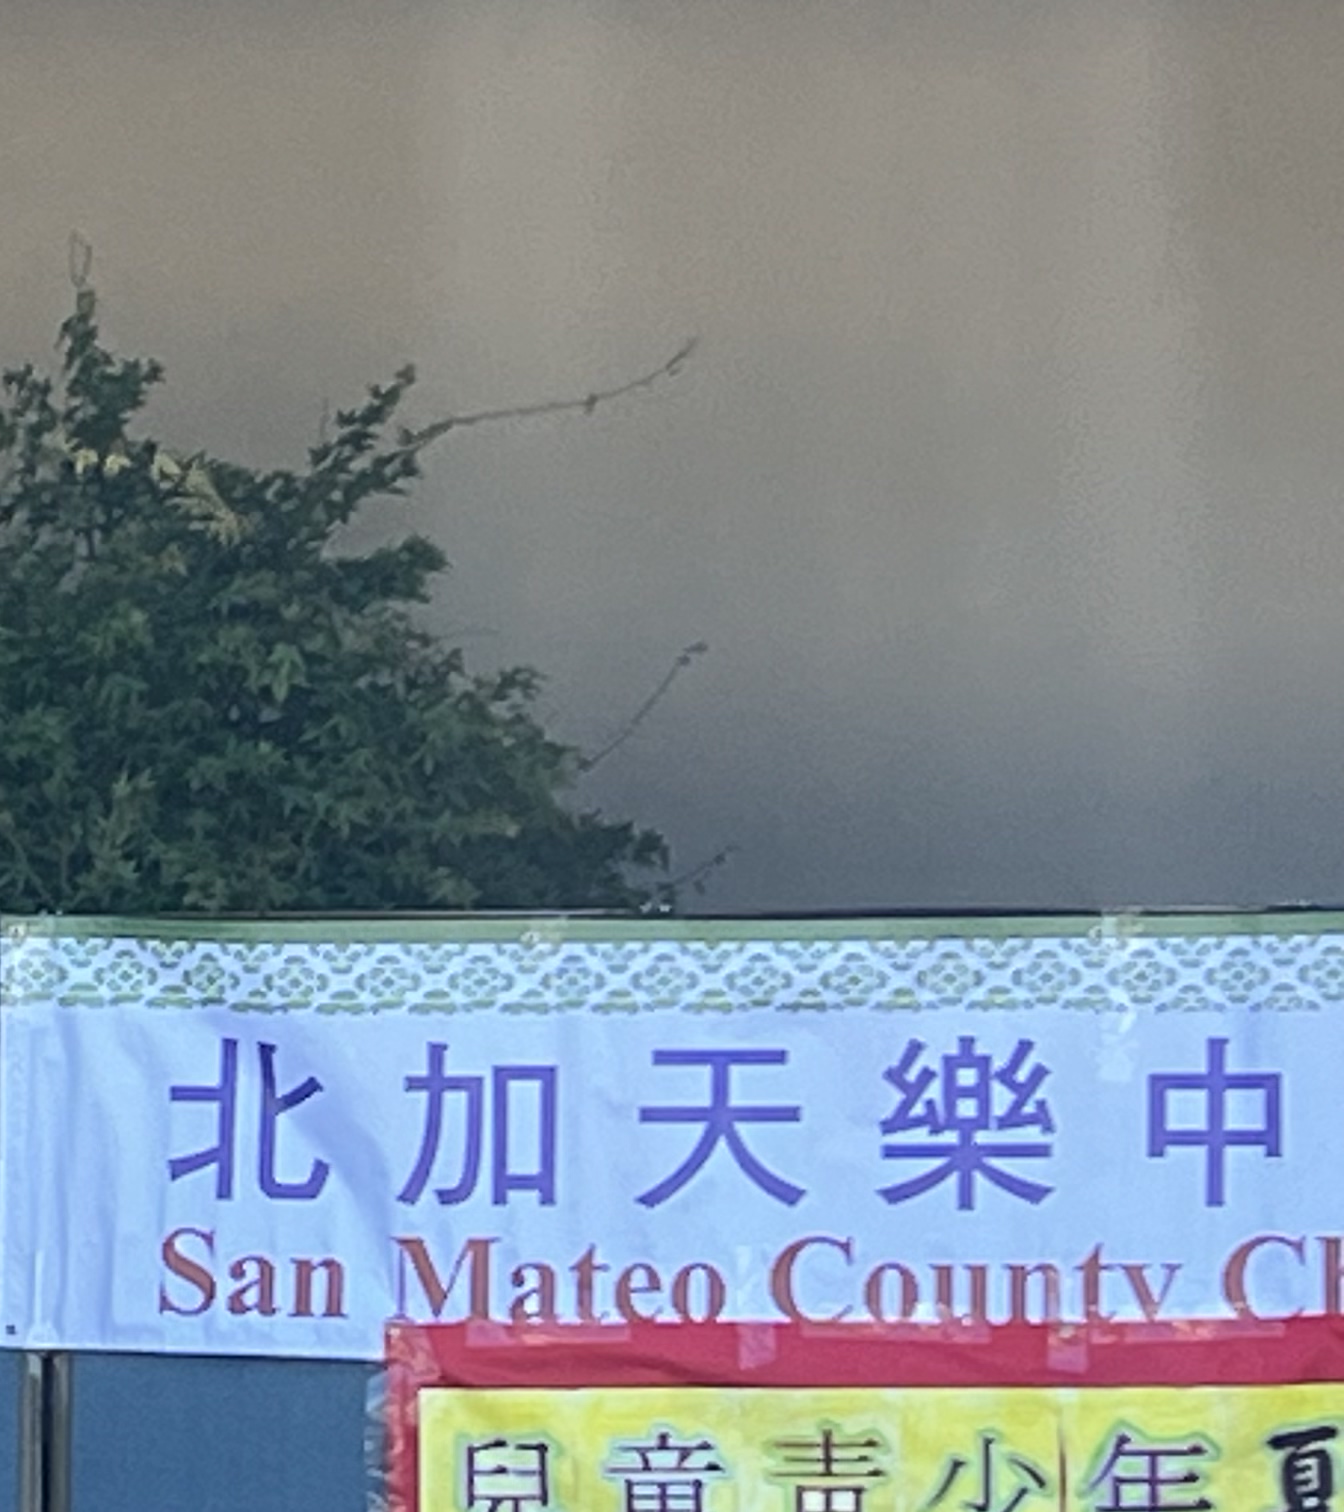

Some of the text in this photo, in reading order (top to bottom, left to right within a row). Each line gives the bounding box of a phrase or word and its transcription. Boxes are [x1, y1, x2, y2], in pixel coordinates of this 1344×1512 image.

[167, 1036, 1285, 1209] 北加天樂中
[158, 1228, 346, 1320] San
[391, 1236, 727, 1324] Mateo
